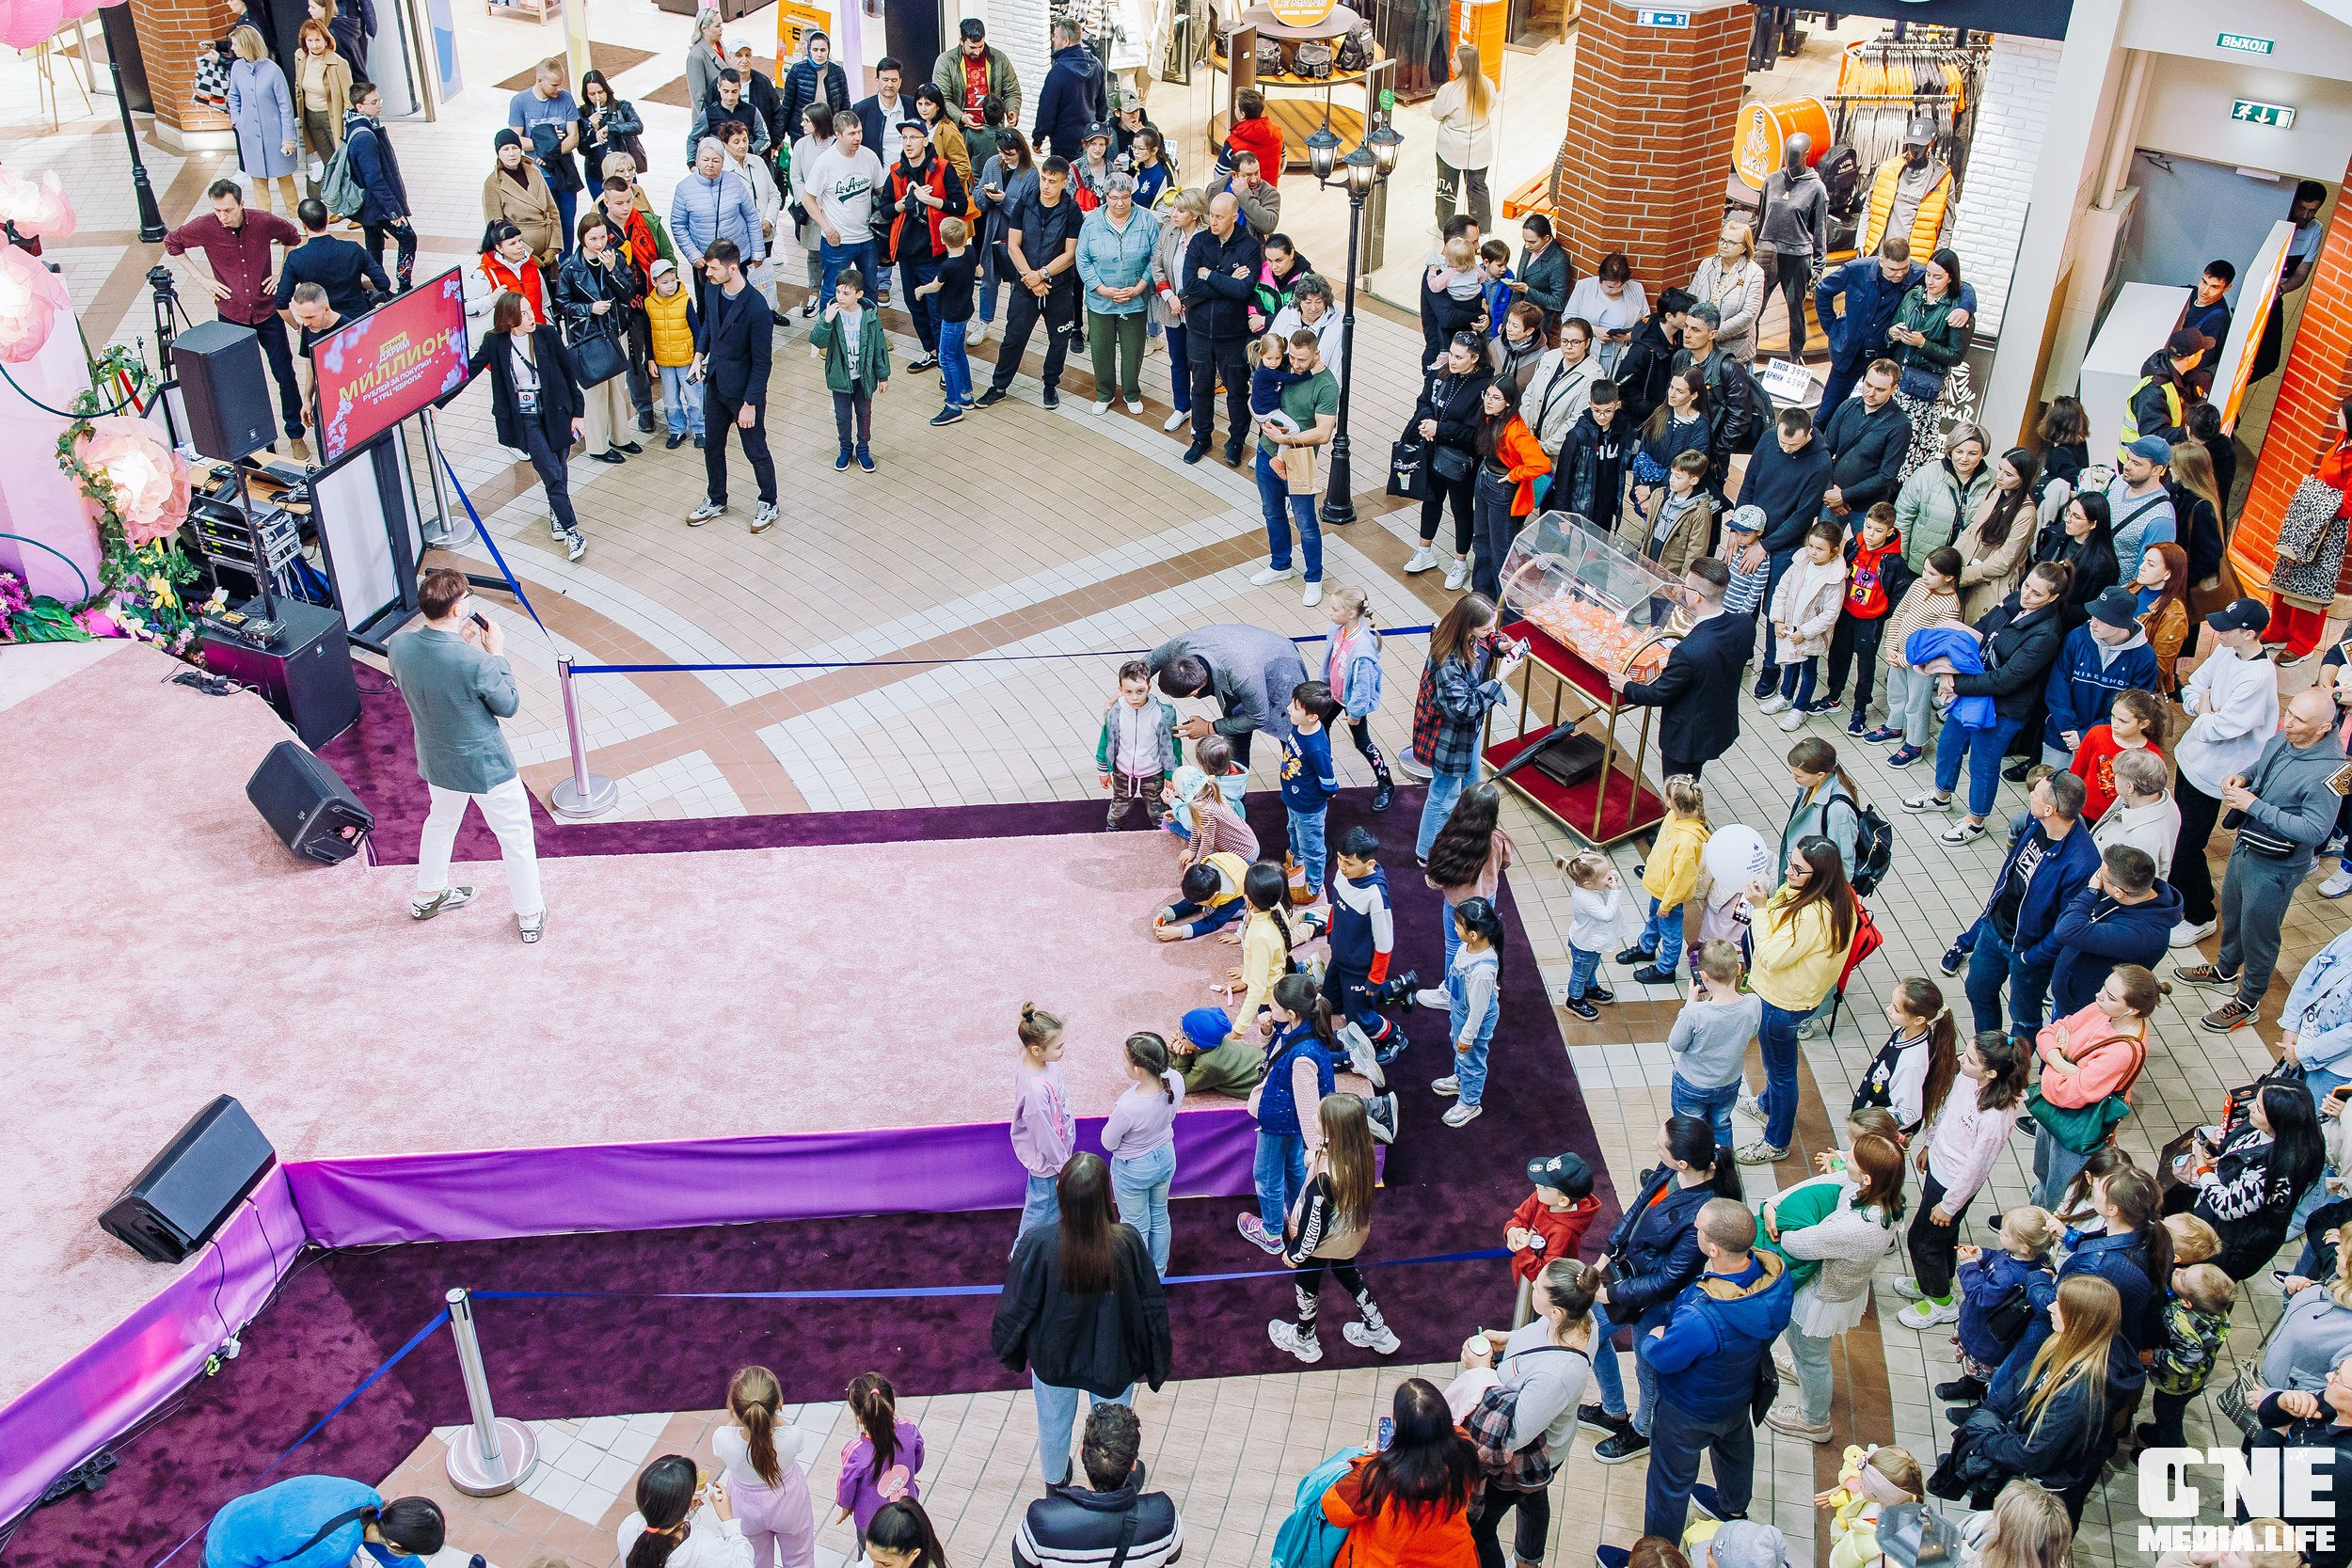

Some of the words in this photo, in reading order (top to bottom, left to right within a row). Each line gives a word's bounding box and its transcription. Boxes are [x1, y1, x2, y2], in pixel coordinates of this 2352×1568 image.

[2221, 35, 2269, 54] ВЫХОД
[379, 339, 410, 364] ДАРИМ
[339, 327, 450, 402] МИЛЛИОН
[1772, 360, 1789, 372] БЛУЗА
[1789, 366, 1811, 379] 3999
[362, 381, 390, 403] РУБЛЕЙ
[390, 377, 401, 388] ЗА
[400, 357, 432, 381] ПОКУПКИ
[1766, 371, 1785, 382] БРЮКИ
[1786, 377, 1805, 390] 4399
[373, 397, 379, 405] В
[378, 390, 393, 402] ТРЦ
[1336, 899, 1347, 911] FILA
[1300, 1203, 1322, 1259] BROOKLYN
